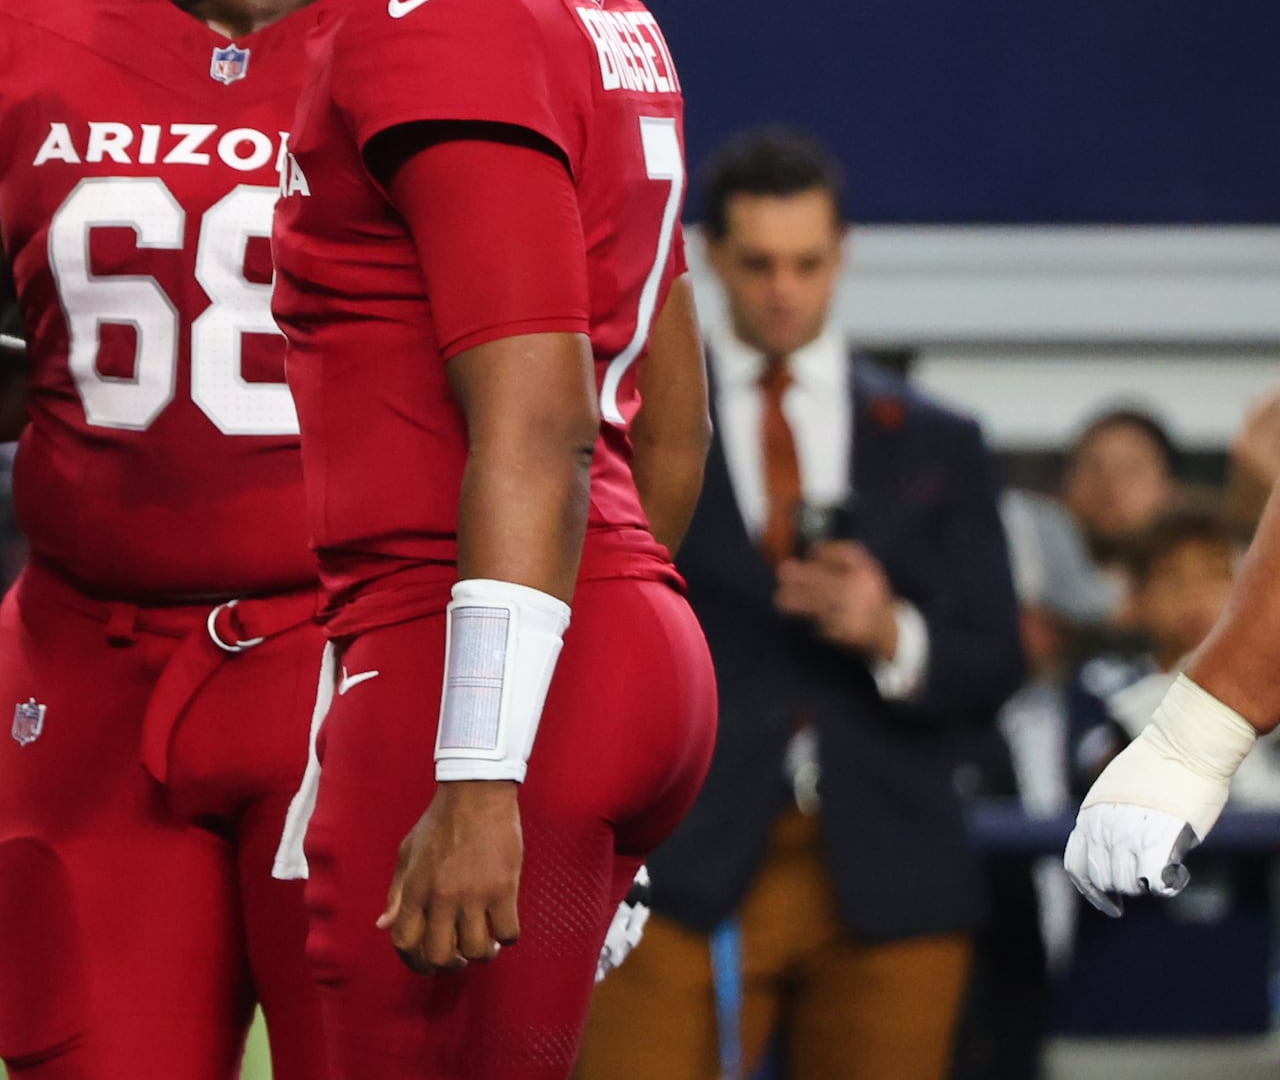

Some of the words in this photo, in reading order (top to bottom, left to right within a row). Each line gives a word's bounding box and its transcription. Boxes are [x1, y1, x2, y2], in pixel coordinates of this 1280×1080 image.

[33, 122, 290, 172] ARIZO
[599, 116, 684, 424] 7
[47, 176, 300, 435] 68
